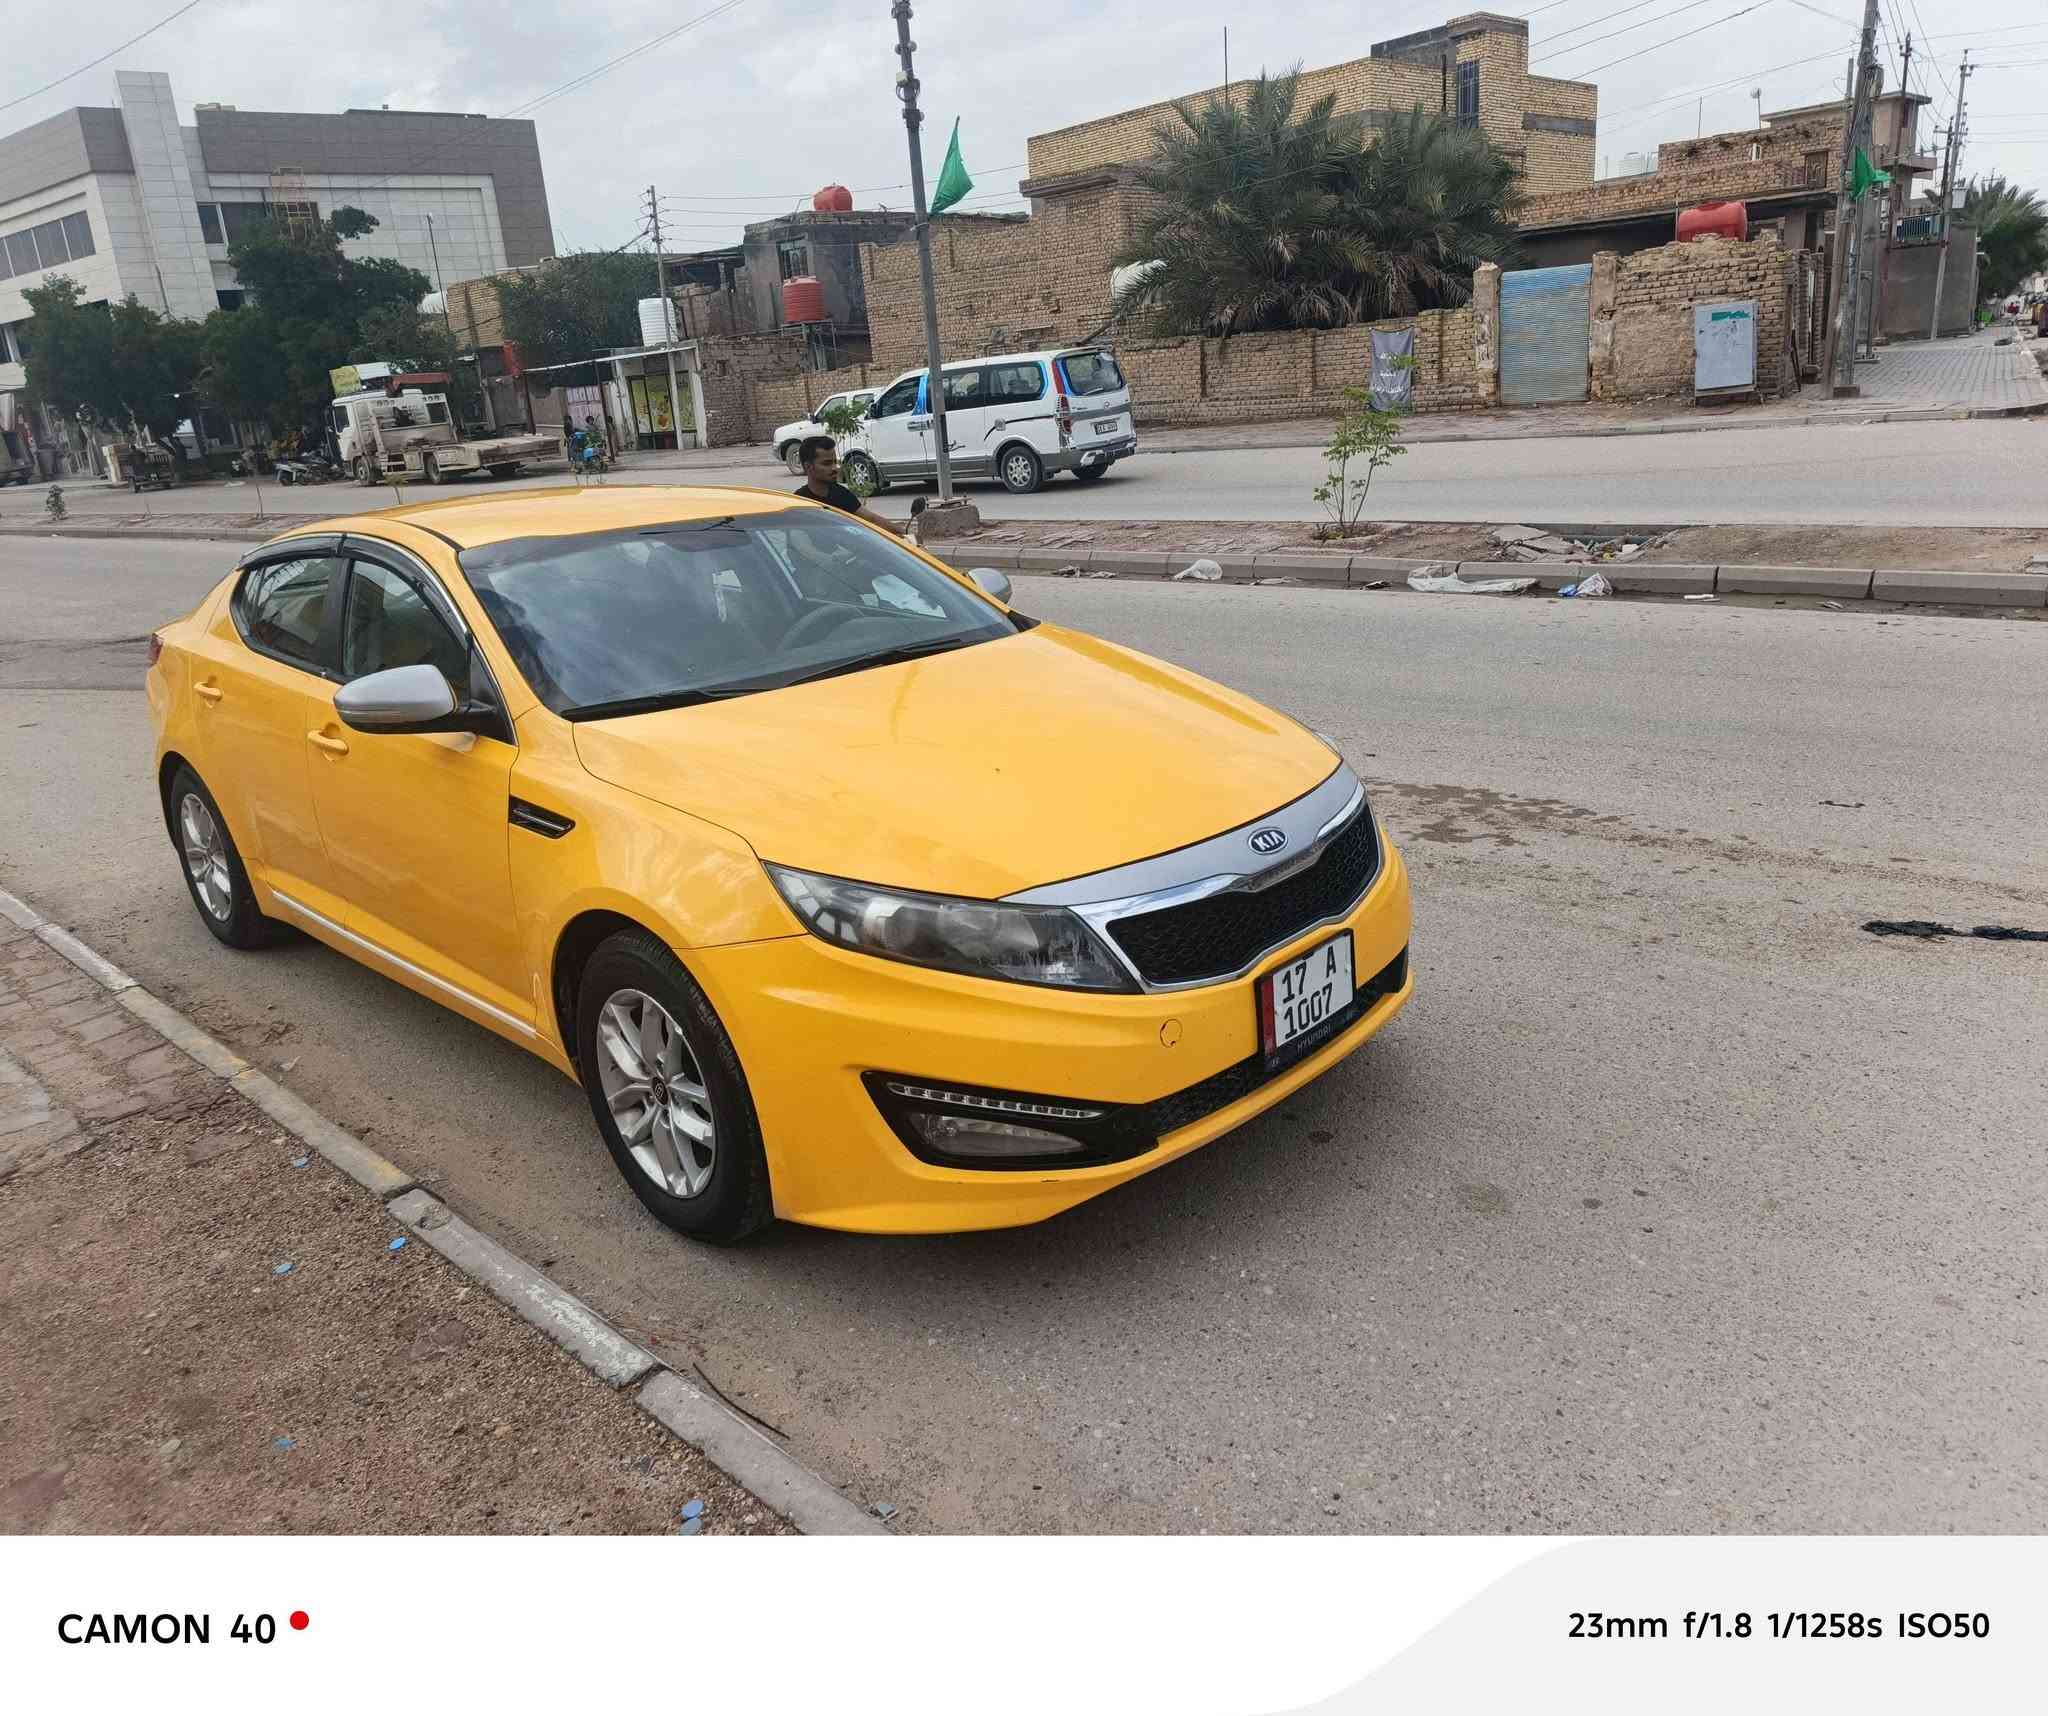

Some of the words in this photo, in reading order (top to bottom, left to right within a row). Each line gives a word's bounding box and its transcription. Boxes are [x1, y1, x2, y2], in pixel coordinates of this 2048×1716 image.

[1253, 830, 1285, 851] KIA
[1281, 960, 1307, 1004] 17
[1326, 945, 1337, 978] A
[1284, 981, 1333, 1040] 1007
